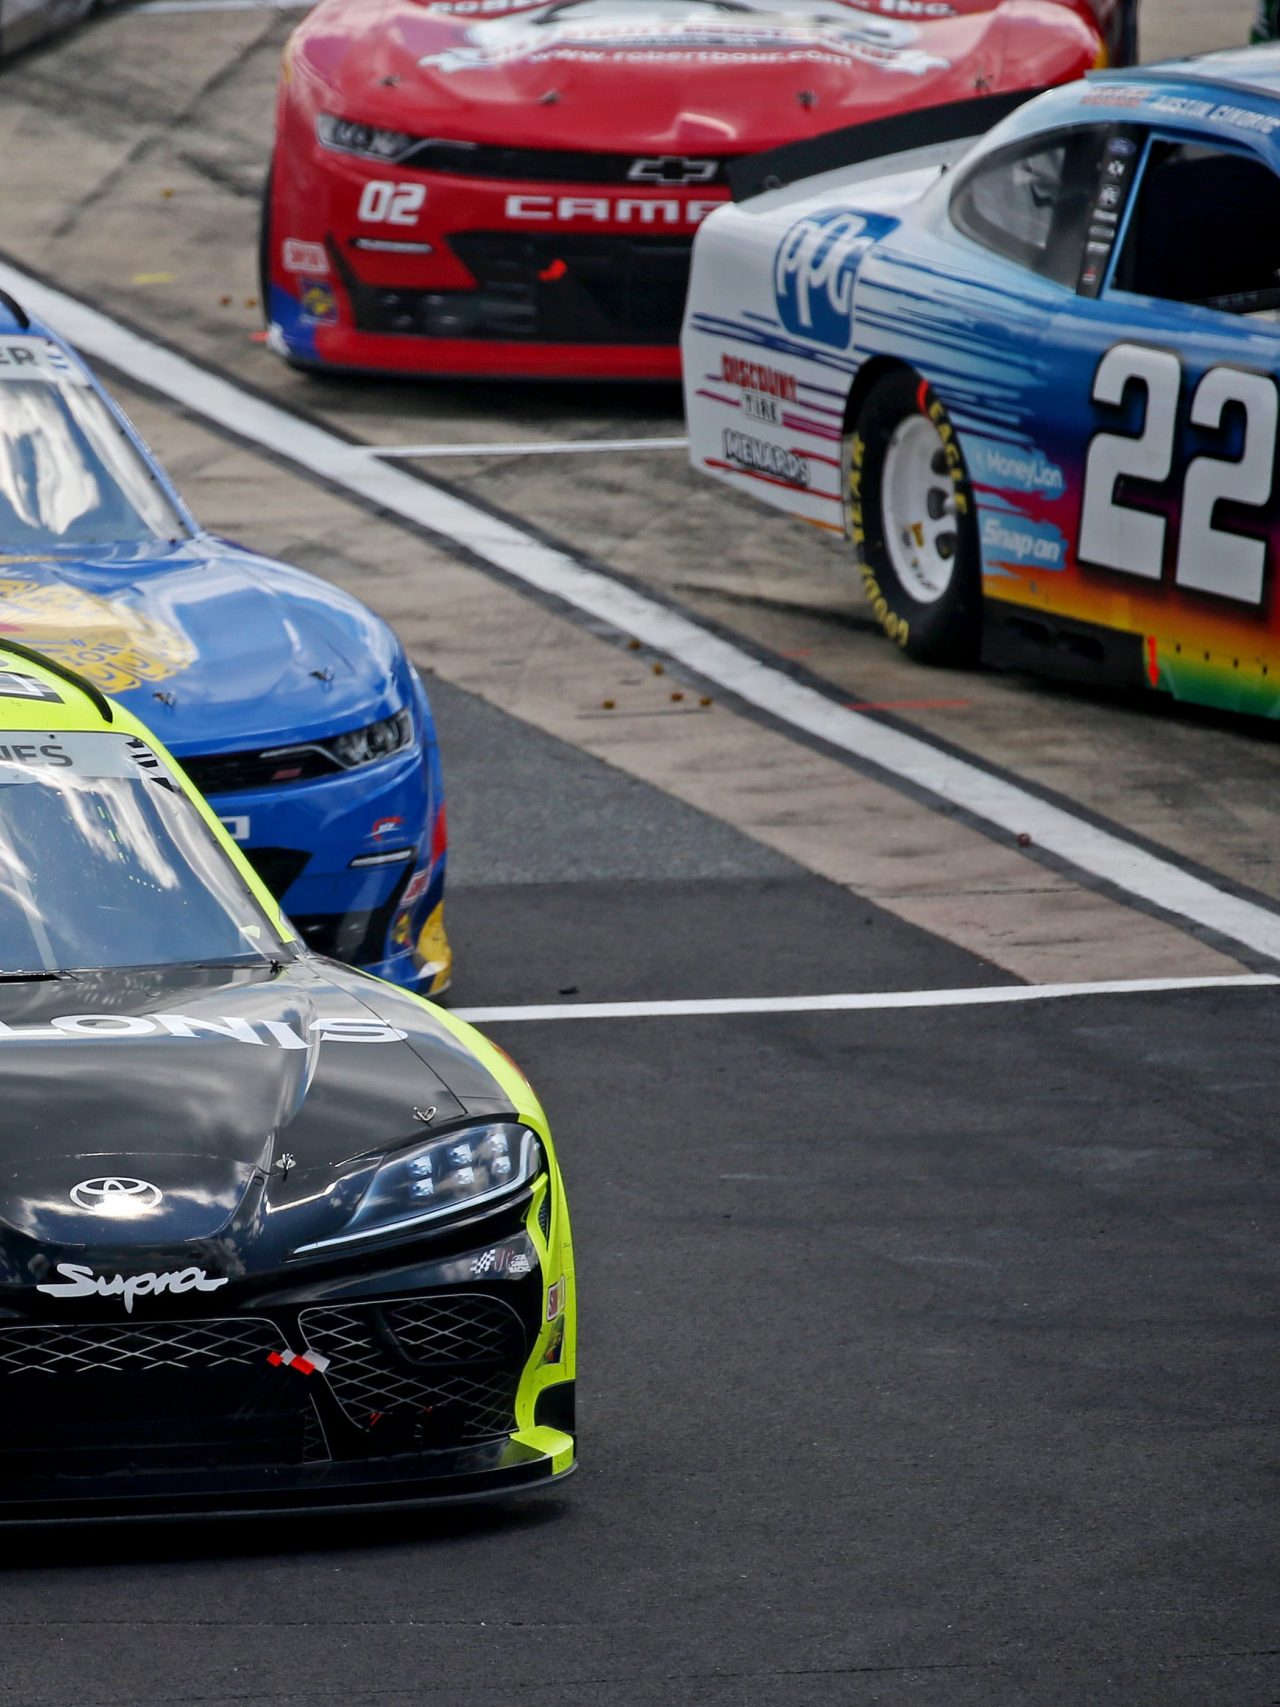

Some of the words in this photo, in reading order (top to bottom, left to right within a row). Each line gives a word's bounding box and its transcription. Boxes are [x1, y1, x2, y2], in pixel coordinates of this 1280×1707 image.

[358, 180, 426, 225] 02
[721, 353, 798, 401] DISCOUNT
[723, 428, 813, 488] MENARDS
[986, 450, 1063, 488] MoneyLion
[1077, 341, 1279, 606] 22
[36, 1262, 229, 1314] Supra
